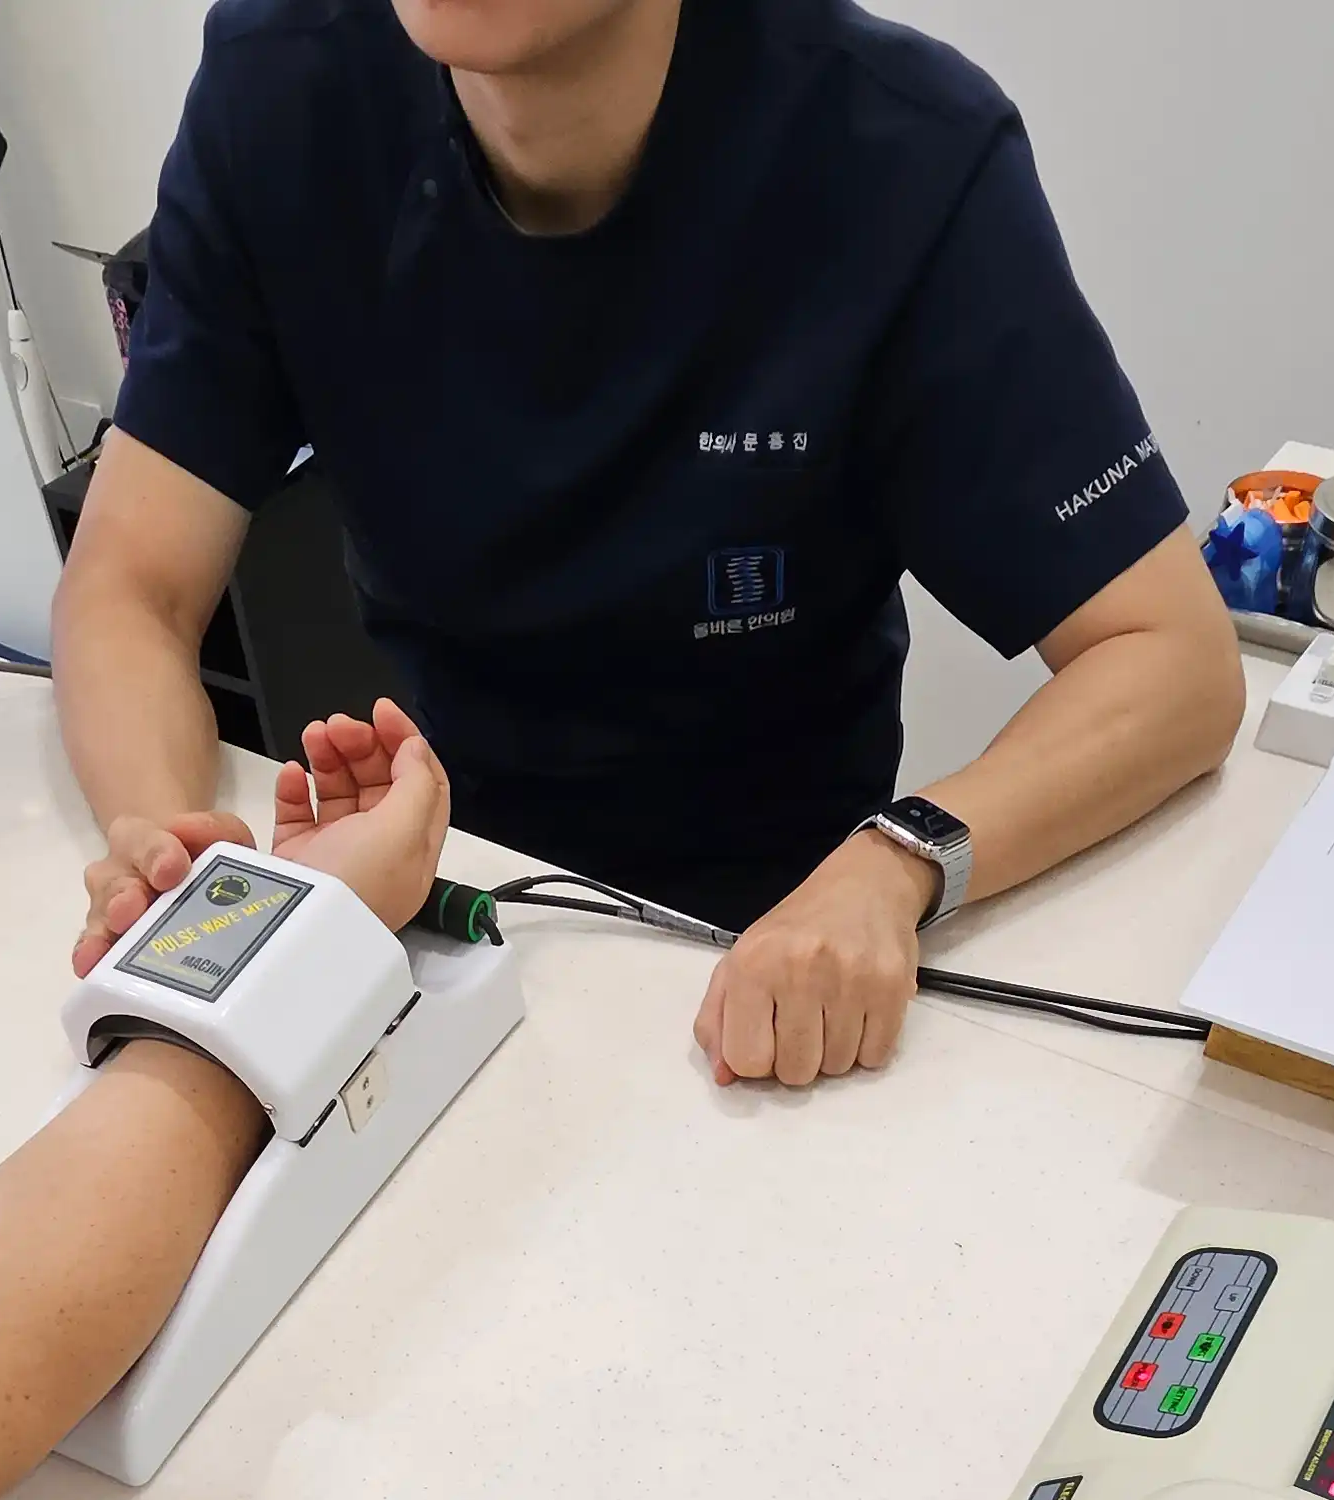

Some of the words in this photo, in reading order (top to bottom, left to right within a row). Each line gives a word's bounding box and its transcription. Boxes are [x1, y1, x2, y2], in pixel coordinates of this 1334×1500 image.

[698, 431, 737, 454] 한의사
[1054, 454, 1138, 522] HAKUNA
[150, 926, 201, 957] PULSE
[197, 910, 242, 935] WAVE
[241, 891, 290, 917] METER
[1186, 1266, 1203, 1289] DOWN
[1195, 1336, 1215, 1358] STRT
